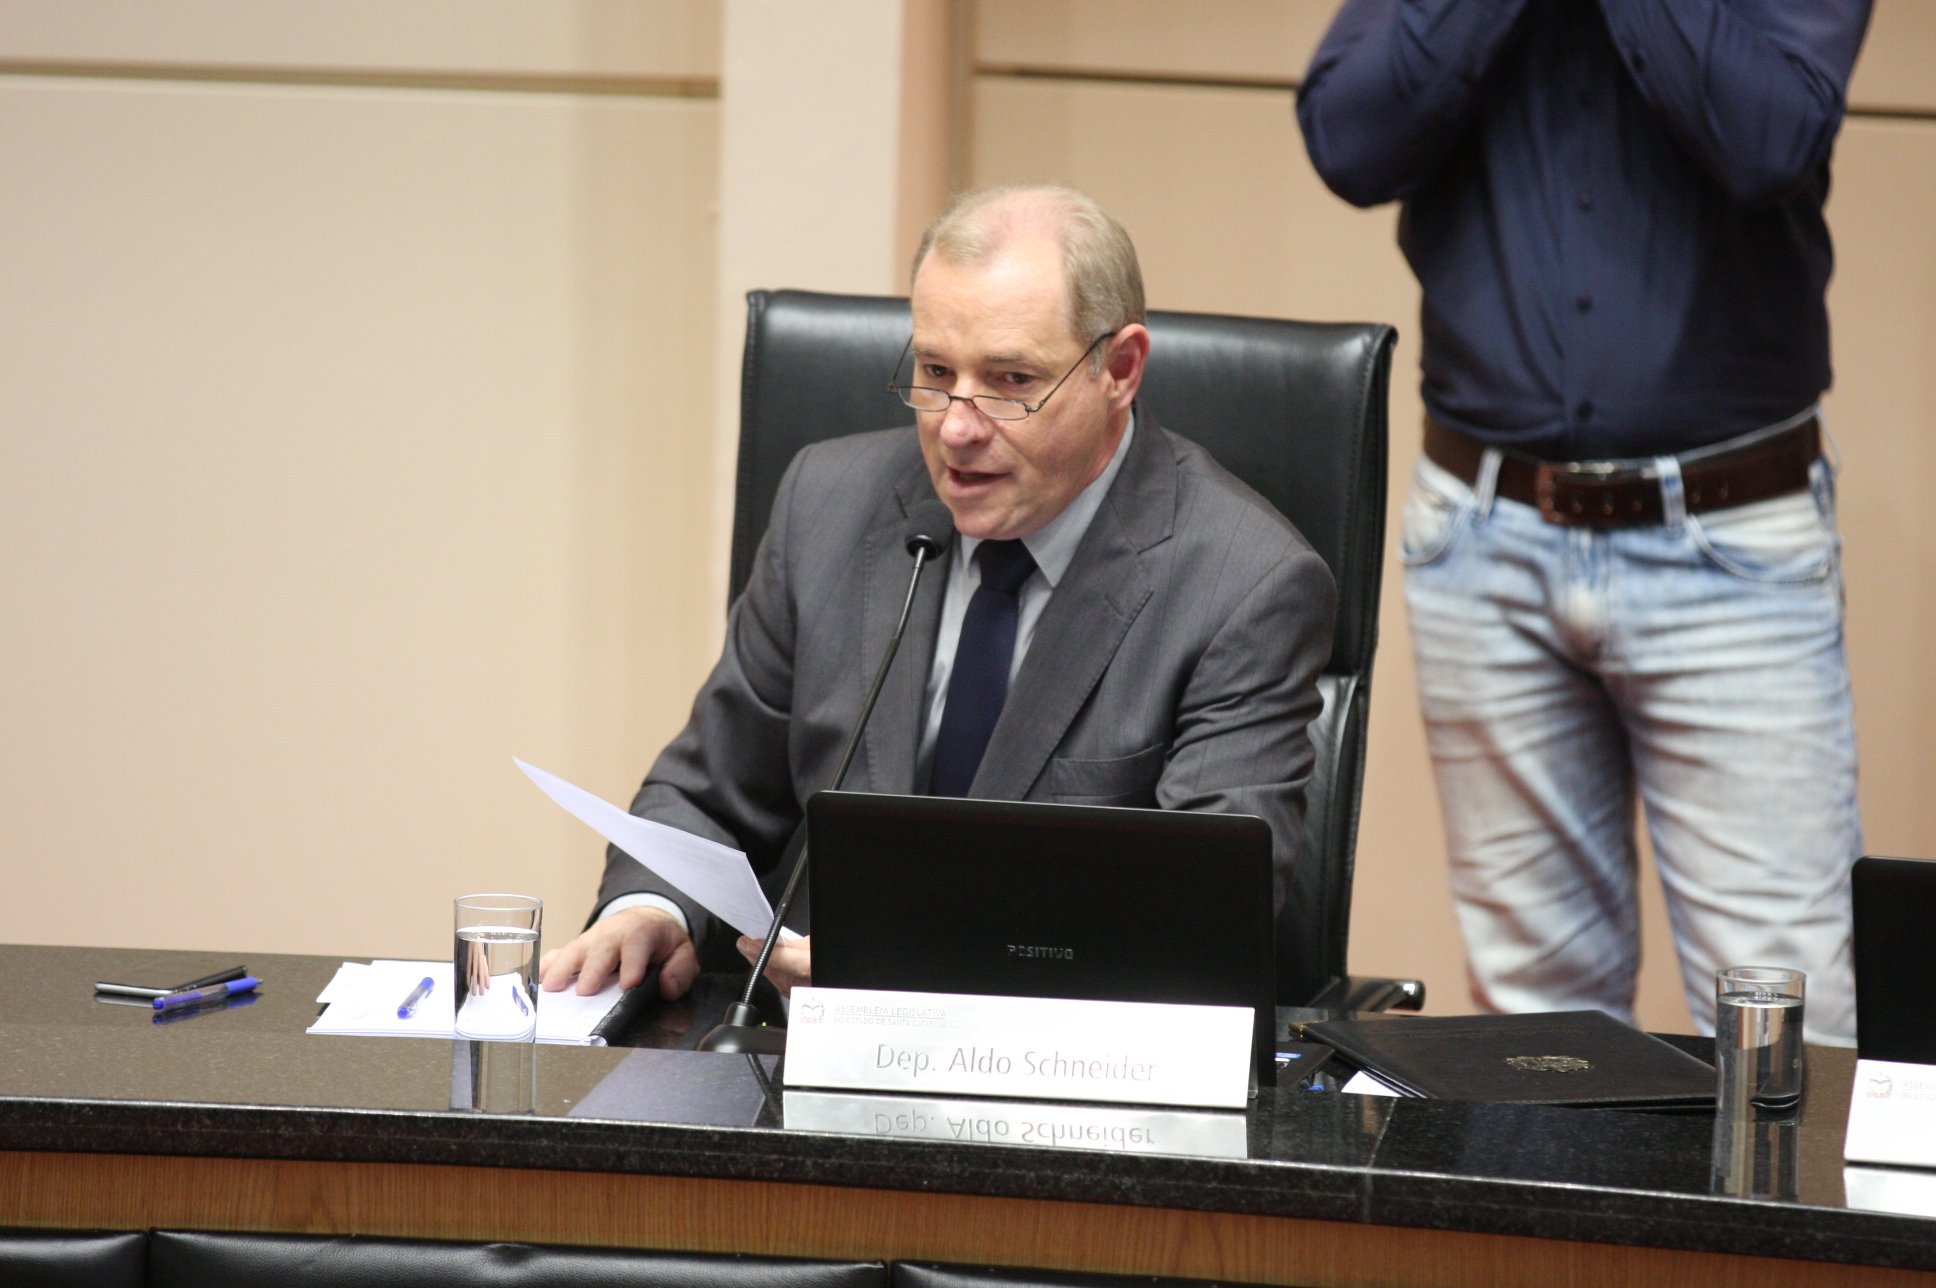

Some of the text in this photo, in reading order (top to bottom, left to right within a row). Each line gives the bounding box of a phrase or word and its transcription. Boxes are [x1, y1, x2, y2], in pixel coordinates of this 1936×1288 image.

[1006, 944, 1074, 960] POSITIVO
[891, 1007, 947, 1018] LEGISLATIVA
[846, 1016, 875, 1025] ESTADO
[876, 1017, 886, 1026] DE
[887, 1018, 911, 1027] SANTA
[912, 1020, 947, 1029] CATARINA
[876, 1043, 1157, 1081] Dep. Aldo Schneider
